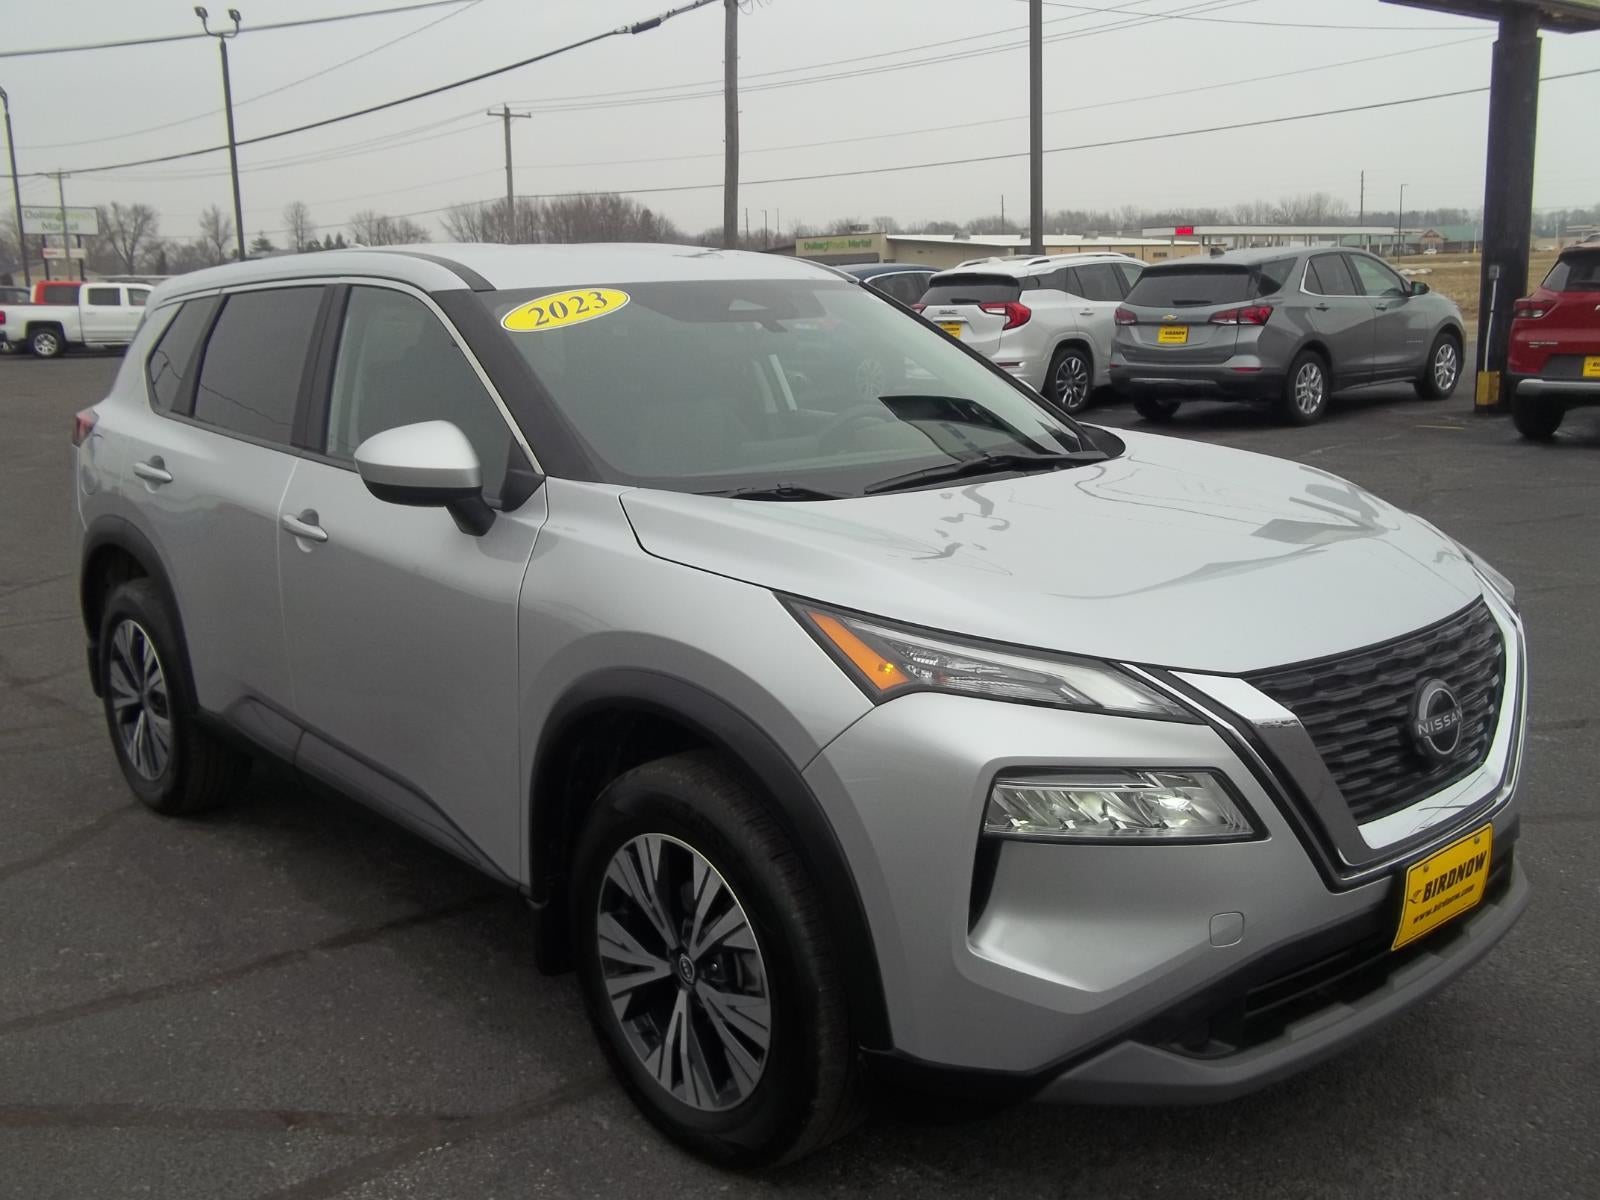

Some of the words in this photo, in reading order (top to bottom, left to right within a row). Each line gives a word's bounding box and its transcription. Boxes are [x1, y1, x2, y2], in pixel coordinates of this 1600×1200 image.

[41, 222, 79, 231] Maret
[528, 291, 608, 326] 2023
[1418, 706, 1463, 735] NISSAN
[1422, 850, 1488, 903] BIRDNOW
